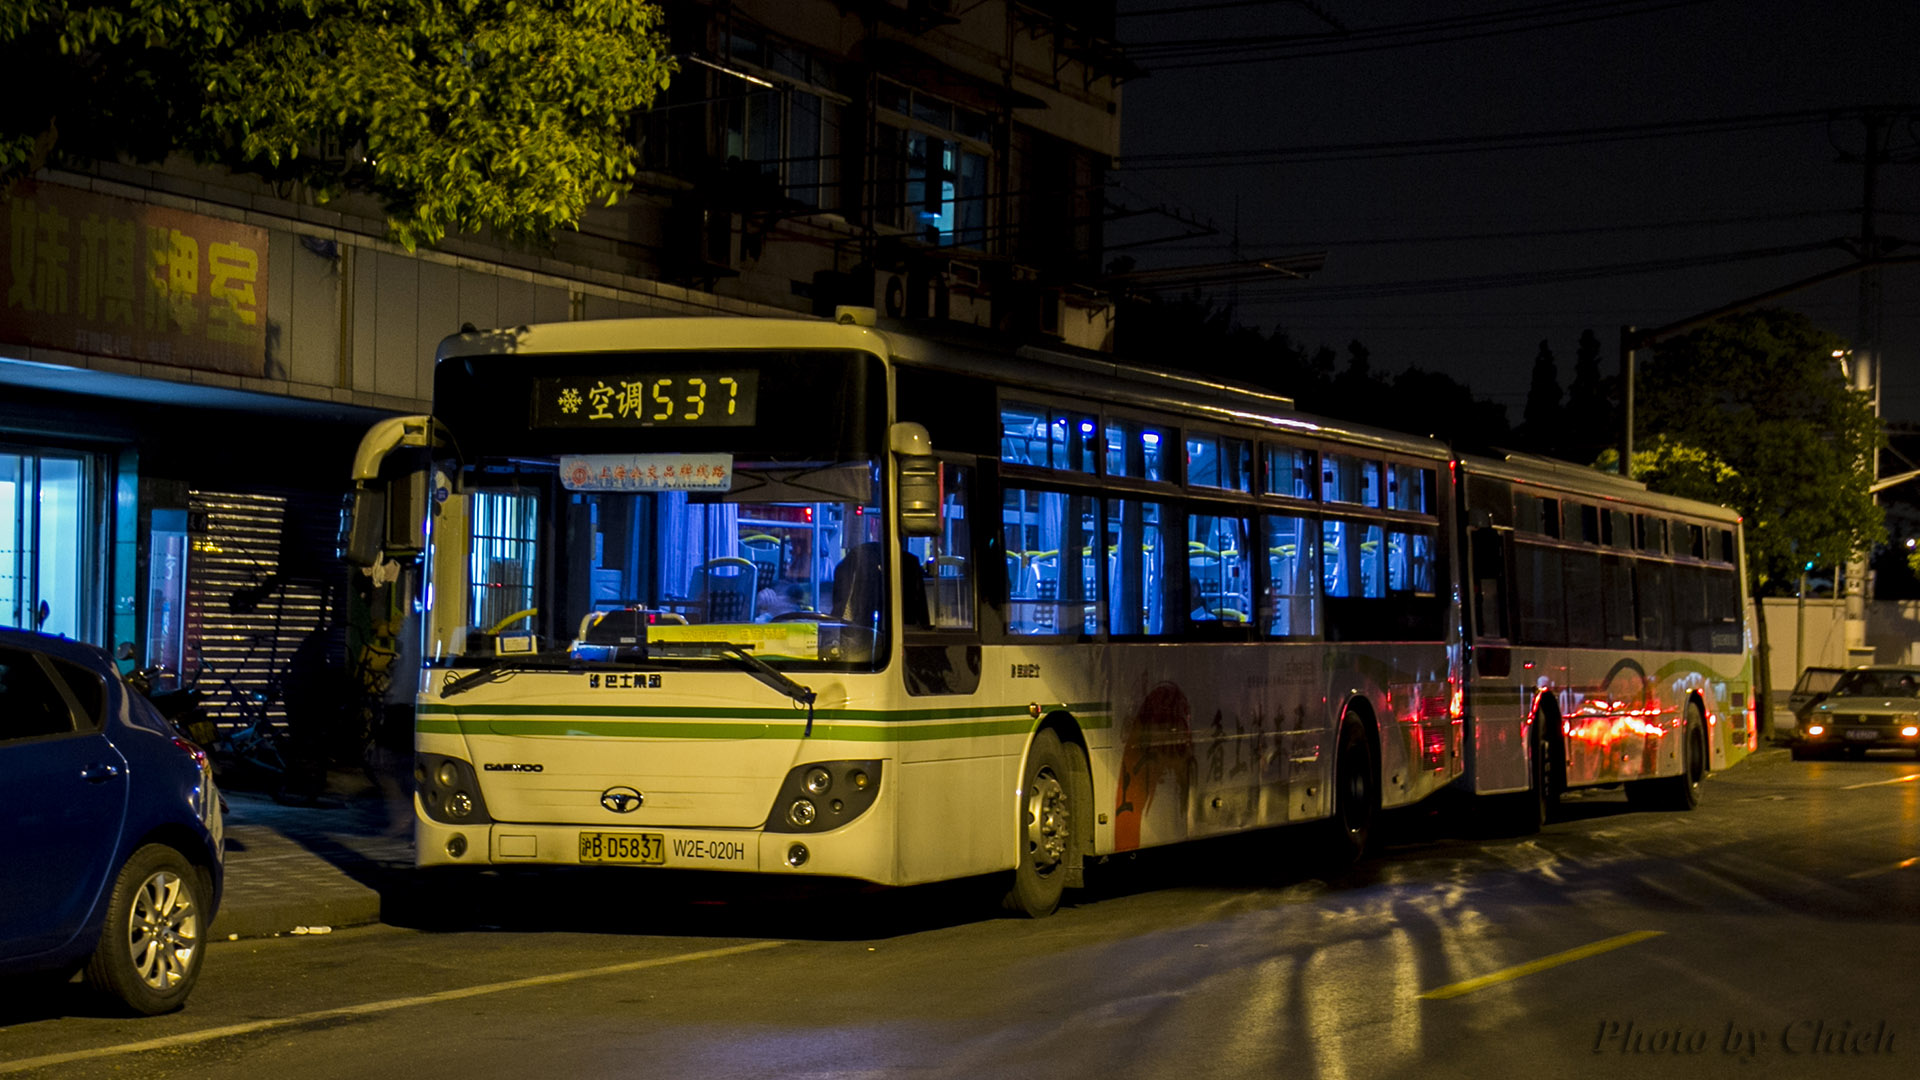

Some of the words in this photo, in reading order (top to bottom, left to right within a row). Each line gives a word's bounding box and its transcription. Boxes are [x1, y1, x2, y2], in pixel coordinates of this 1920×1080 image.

[588, 380, 643, 421] 空调
[652, 376, 739, 421] 537
[598, 463, 726, 480] 上海公交品牌线路
[484, 763, 544, 773] DAEWOO
[673, 838, 745, 861] W2E-020H
